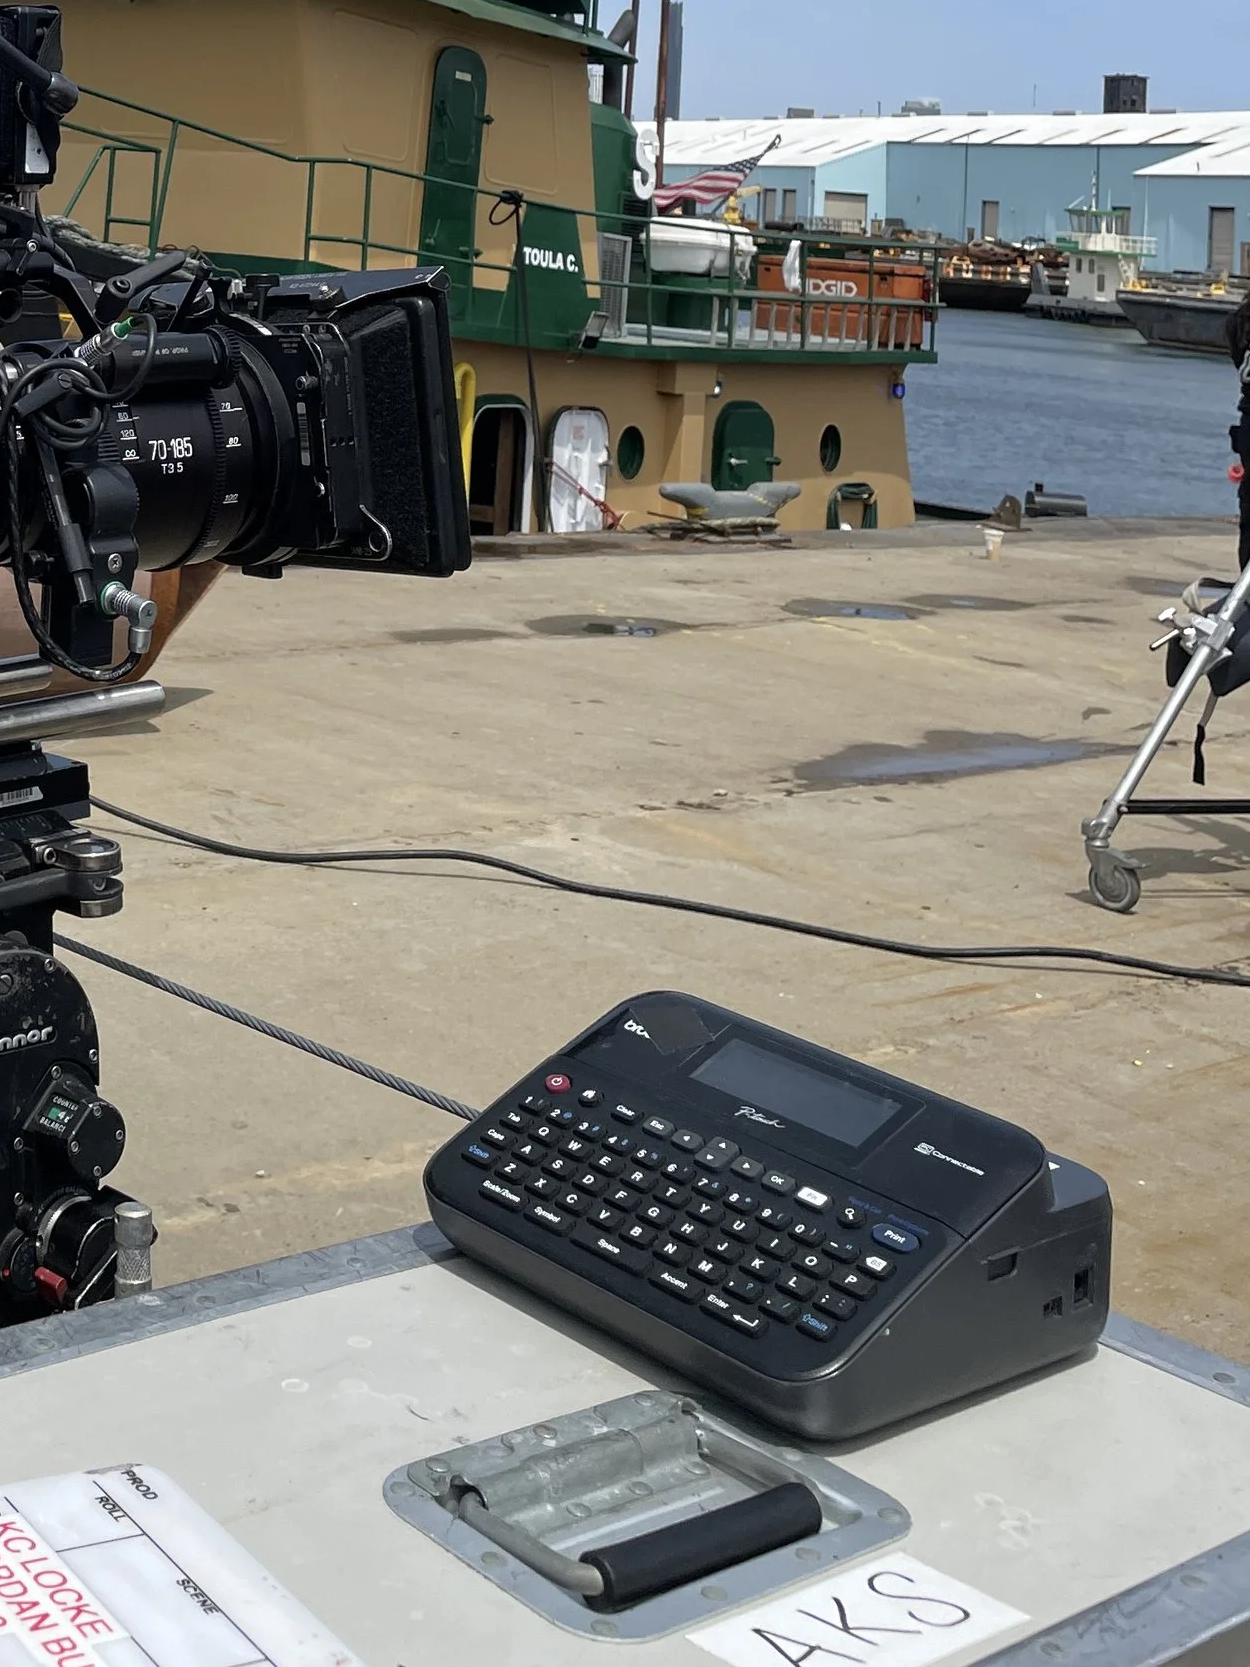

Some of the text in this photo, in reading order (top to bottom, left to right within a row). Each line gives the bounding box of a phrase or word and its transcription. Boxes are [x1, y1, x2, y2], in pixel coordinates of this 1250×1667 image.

[522, 246, 579, 272] TOULA C.
[801, 276, 858, 297] IDGID
[148, 436, 193, 461] 70-185
[550, 1108, 561, 1118] 2
[616, 1104, 635, 1116] Clear
[508, 1112, 521, 1123] Tab
[578, 1122, 589, 1131] 3
[650, 1120, 665, 1130] Esc
[487, 1128, 505, 1141] Caps
[538, 1126, 550, 1137] Q
[520, 1145, 532, 1154] A
[568, 1139, 582, 1151] W
[637, 1149, 648, 1158] 5
[552, 1159, 564, 1169] S
[599, 1156, 612, 1166] E
[504, 1162, 517, 1173] Z
[667, 1163, 678, 1172] 6
[582, 1174, 595, 1184] D
[631, 1171, 643, 1182] R
[770, 1175, 785, 1185] OK
[534, 1177, 547, 1189] X
[482, 1179, 521, 1203] Scale/Zoom
[615, 1190, 628, 1199] F
[666, 1186, 677, 1197] T
[566, 1194, 578, 1204] C
[729, 1193, 740, 1202] 8
[599, 1209, 611, 1219] V
[647, 1206, 660, 1218] G
[699, 1203, 711, 1214] Y
[534, 1206, 561, 1223] Symbol
[630, 1225, 643, 1237] B
[680, 1222, 695, 1234] H
[732, 1220, 746, 1231] U
[883, 1229, 906, 1244] Print
[597, 1238, 621, 1254] Space
[663, 1242, 678, 1254] N
[717, 1242, 729, 1251] J
[751, 1258, 765, 1270] K
[805, 1255, 818, 1266] O
[697, 1260, 713, 1273] M
[660, 1272, 688, 1290] Accent
[844, 1274, 858, 1284] P
[707, 1294, 730, 1310] Enter
[120, 1468, 159, 1501] PROD
[94, 1495, 127, 1523] ROLL
[20, 1556, 114, 1639] LOCKE
[176, 1577, 220, 1616] SCENE
[751, 1570, 971, 1667] AKS
